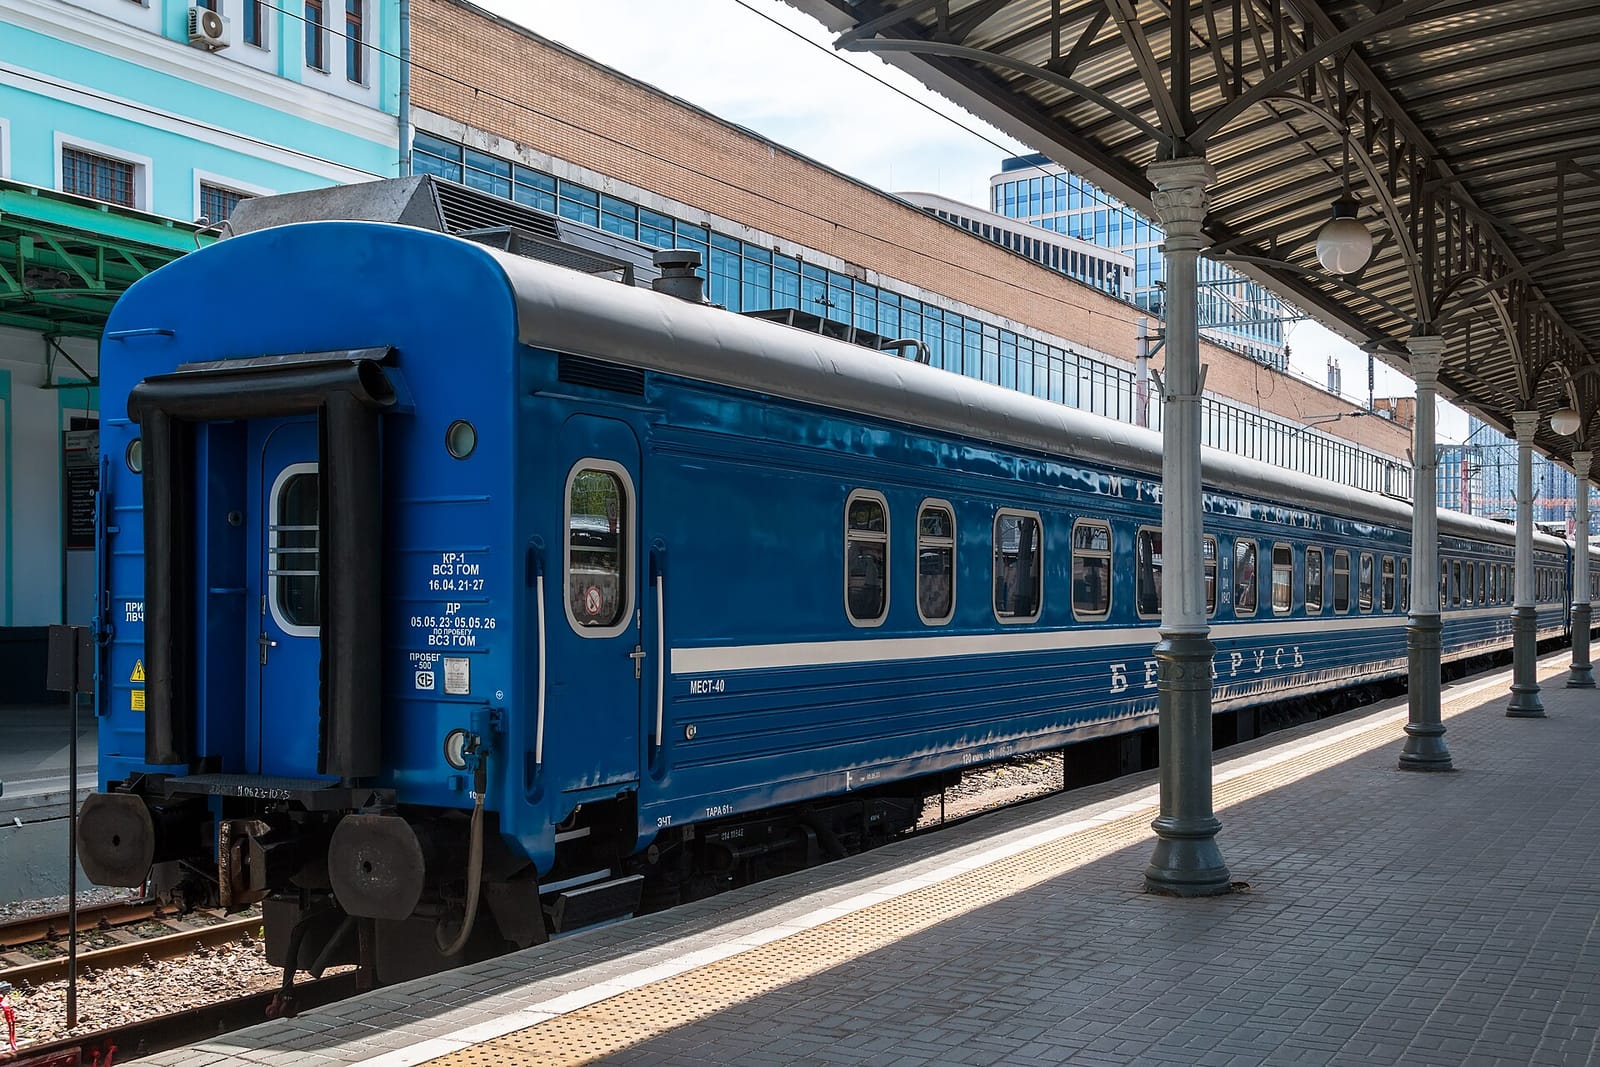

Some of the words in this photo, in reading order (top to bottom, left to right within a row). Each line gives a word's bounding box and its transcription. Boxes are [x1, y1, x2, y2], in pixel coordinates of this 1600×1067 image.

[442, 552, 465, 564] КР-1
[432, 564, 453, 575] ВСЗ
[456, 564, 480, 575] ГОМ
[445, 602, 461, 615] ДР
[428, 634, 450, 646] ВСЗ
[452, 635, 476, 647] ГОМ
[409, 652, 441, 662] ПРОБЕГ
[1109, 646, 1305, 694] БЕРУСЬ
[690, 679, 725, 694] МЕСТ-40
[705, 806, 722, 818] ТАРА
[657, 815, 672, 828] ЭЧТ
